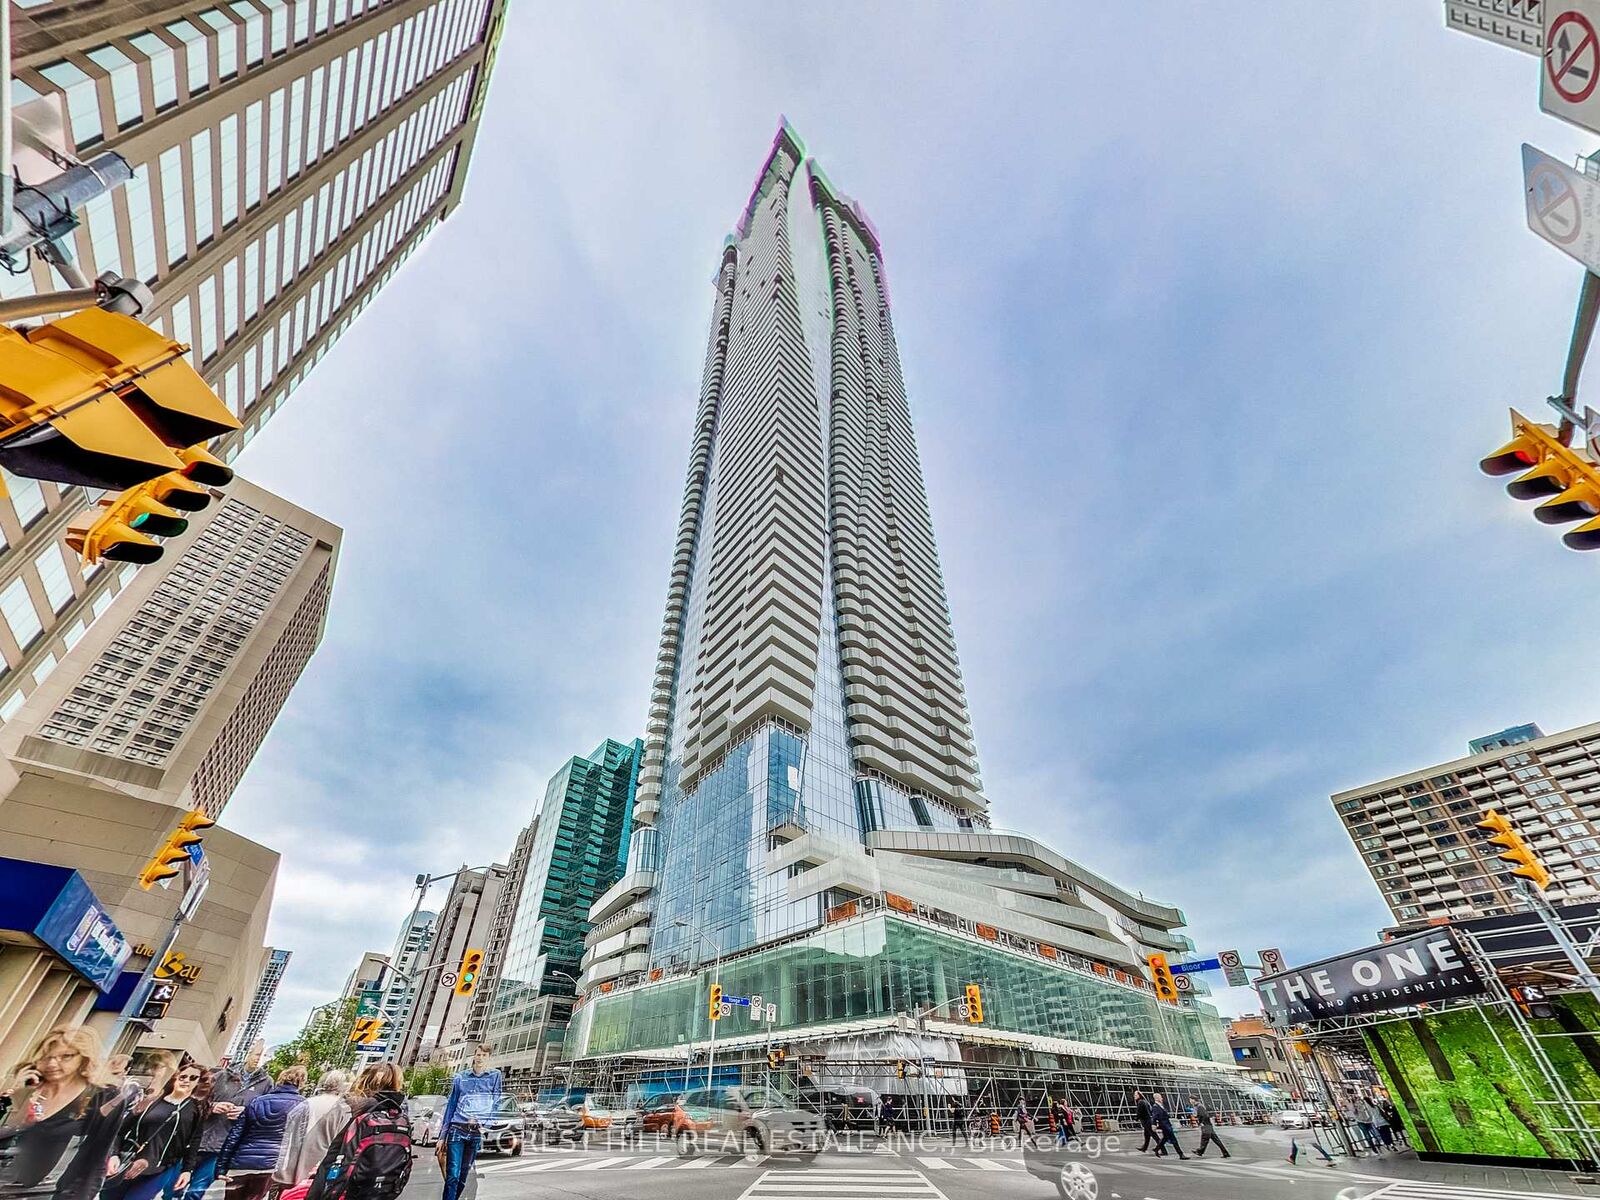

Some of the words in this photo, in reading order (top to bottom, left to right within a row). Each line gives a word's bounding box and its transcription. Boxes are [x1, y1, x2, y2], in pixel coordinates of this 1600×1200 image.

[154, 950, 201, 984] Bay
[1181, 962, 1201, 972] Bloor
[1259, 970, 1336, 1006] THE
[1351, 939, 1464, 987] ONE
[1318, 999, 1344, 1010] AND
[1352, 975, 1474, 1003] RESIDENTIAL
